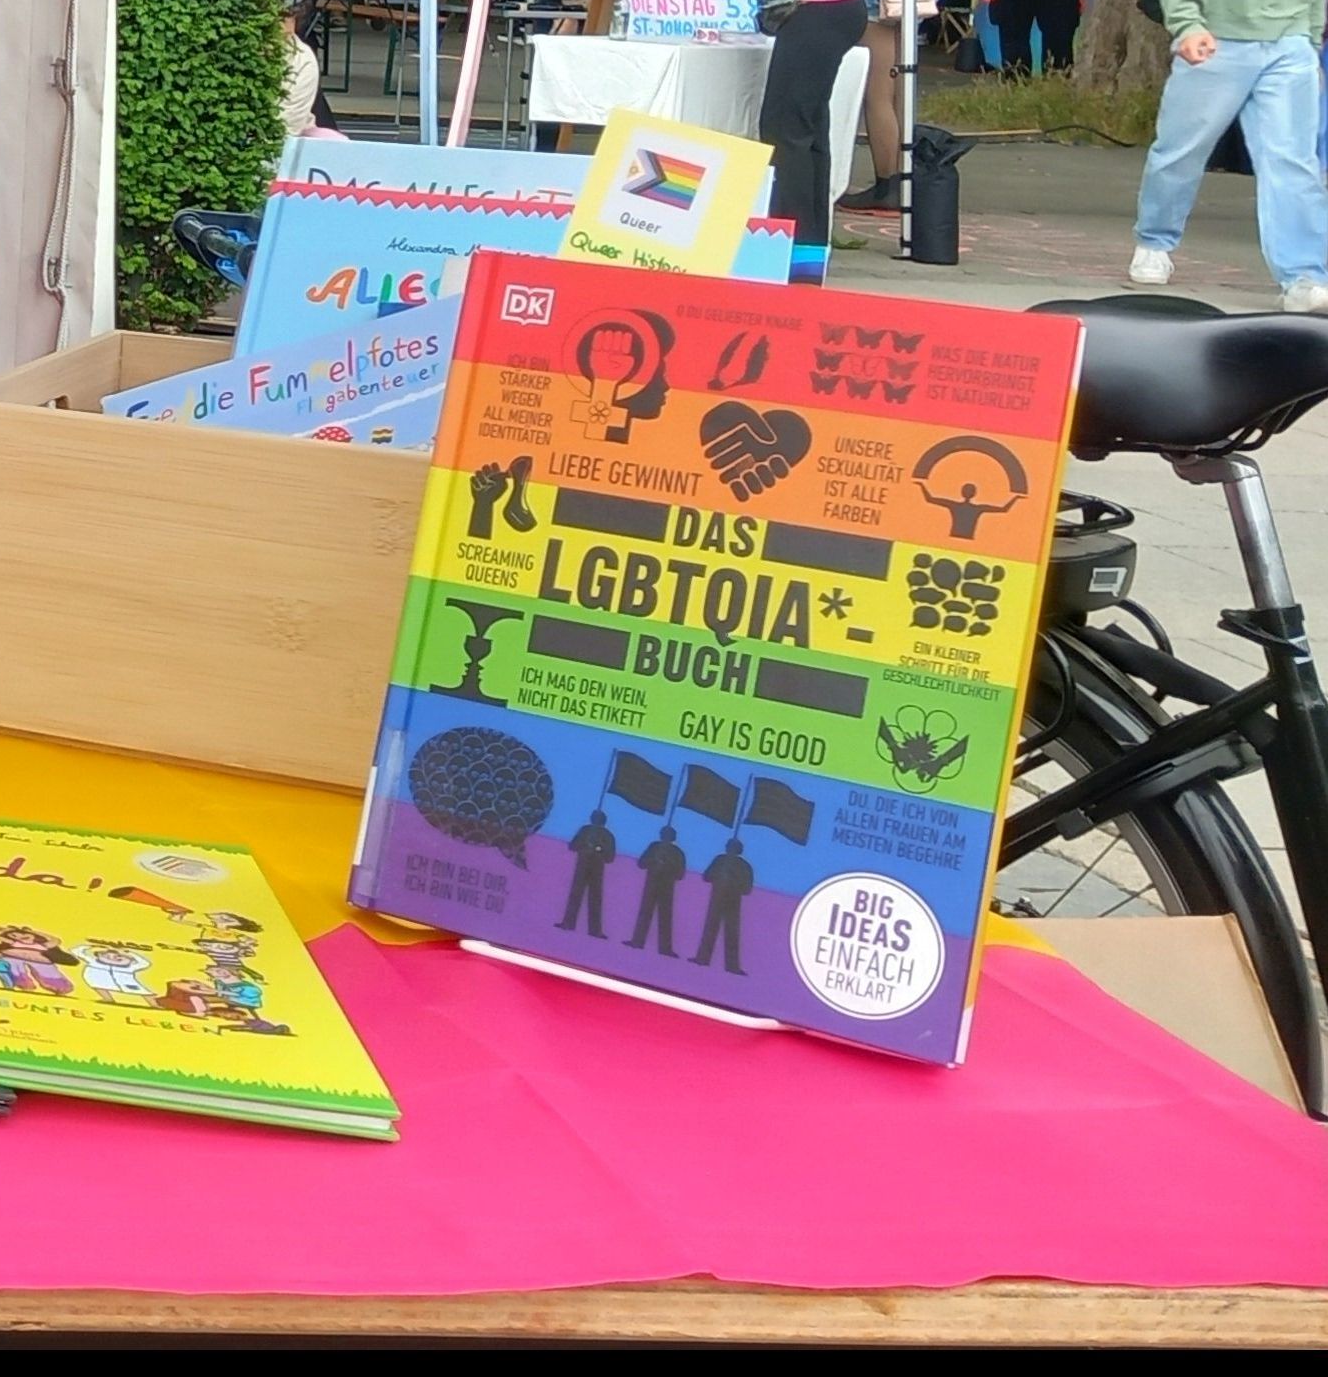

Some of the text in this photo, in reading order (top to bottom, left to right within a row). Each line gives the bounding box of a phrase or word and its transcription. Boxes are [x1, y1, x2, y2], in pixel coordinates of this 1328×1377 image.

[619, 211, 663, 233] Queer
[386, 237, 459, 257] Alexandra
[570, 230, 623, 261] Queer
[509, 295, 548, 317] DK
[967, 349, 1041, 373] DIE NATUR
[499, 368, 552, 391] STÄRKER
[928, 384, 948, 400] IST
[501, 390, 543, 408] WEGEN
[483, 406, 553, 427] ALL MEINER
[478, 421, 552, 446] IDENTITÄTEN
[835, 436, 894, 461] UNSERE
[548, 451, 703, 497] LIEBE GEWINNT
[817, 455, 905, 484] SEXUALITÄT
[824, 480, 889, 505] IST ALLE
[822, 501, 882, 526] FARBEN
[672, 505, 759, 558] DAS
[456, 541, 535, 573] SCREAMING
[464, 564, 521, 589] QUEENS
[632, 632, 754, 696] BUCH
[913, 641, 981, 665] EIN KLEINER
[898, 655, 991, 683] SCHRITT FÜR DIE
[520, 665, 648, 709] ICH MAG DEN WEIN,
[882, 669, 1001, 703] GESCHLECHTLICHKEIT
[517, 687, 647, 729] NICHT DAS ETIKETT
[679, 710, 827, 767] GAY IS GOOD
[875, 795, 959, 828] DIE ICH VON
[834, 807, 967, 851] ALLEN FRAUEN AM
[831, 826, 962, 871] MEISTEN BEGEHRE
[853, 889, 895, 920] BIG
[828, 903, 913, 952] IDEAS
[815, 935, 915, 987] EINFACH
[126, 1014, 223, 1036] LEBEN
